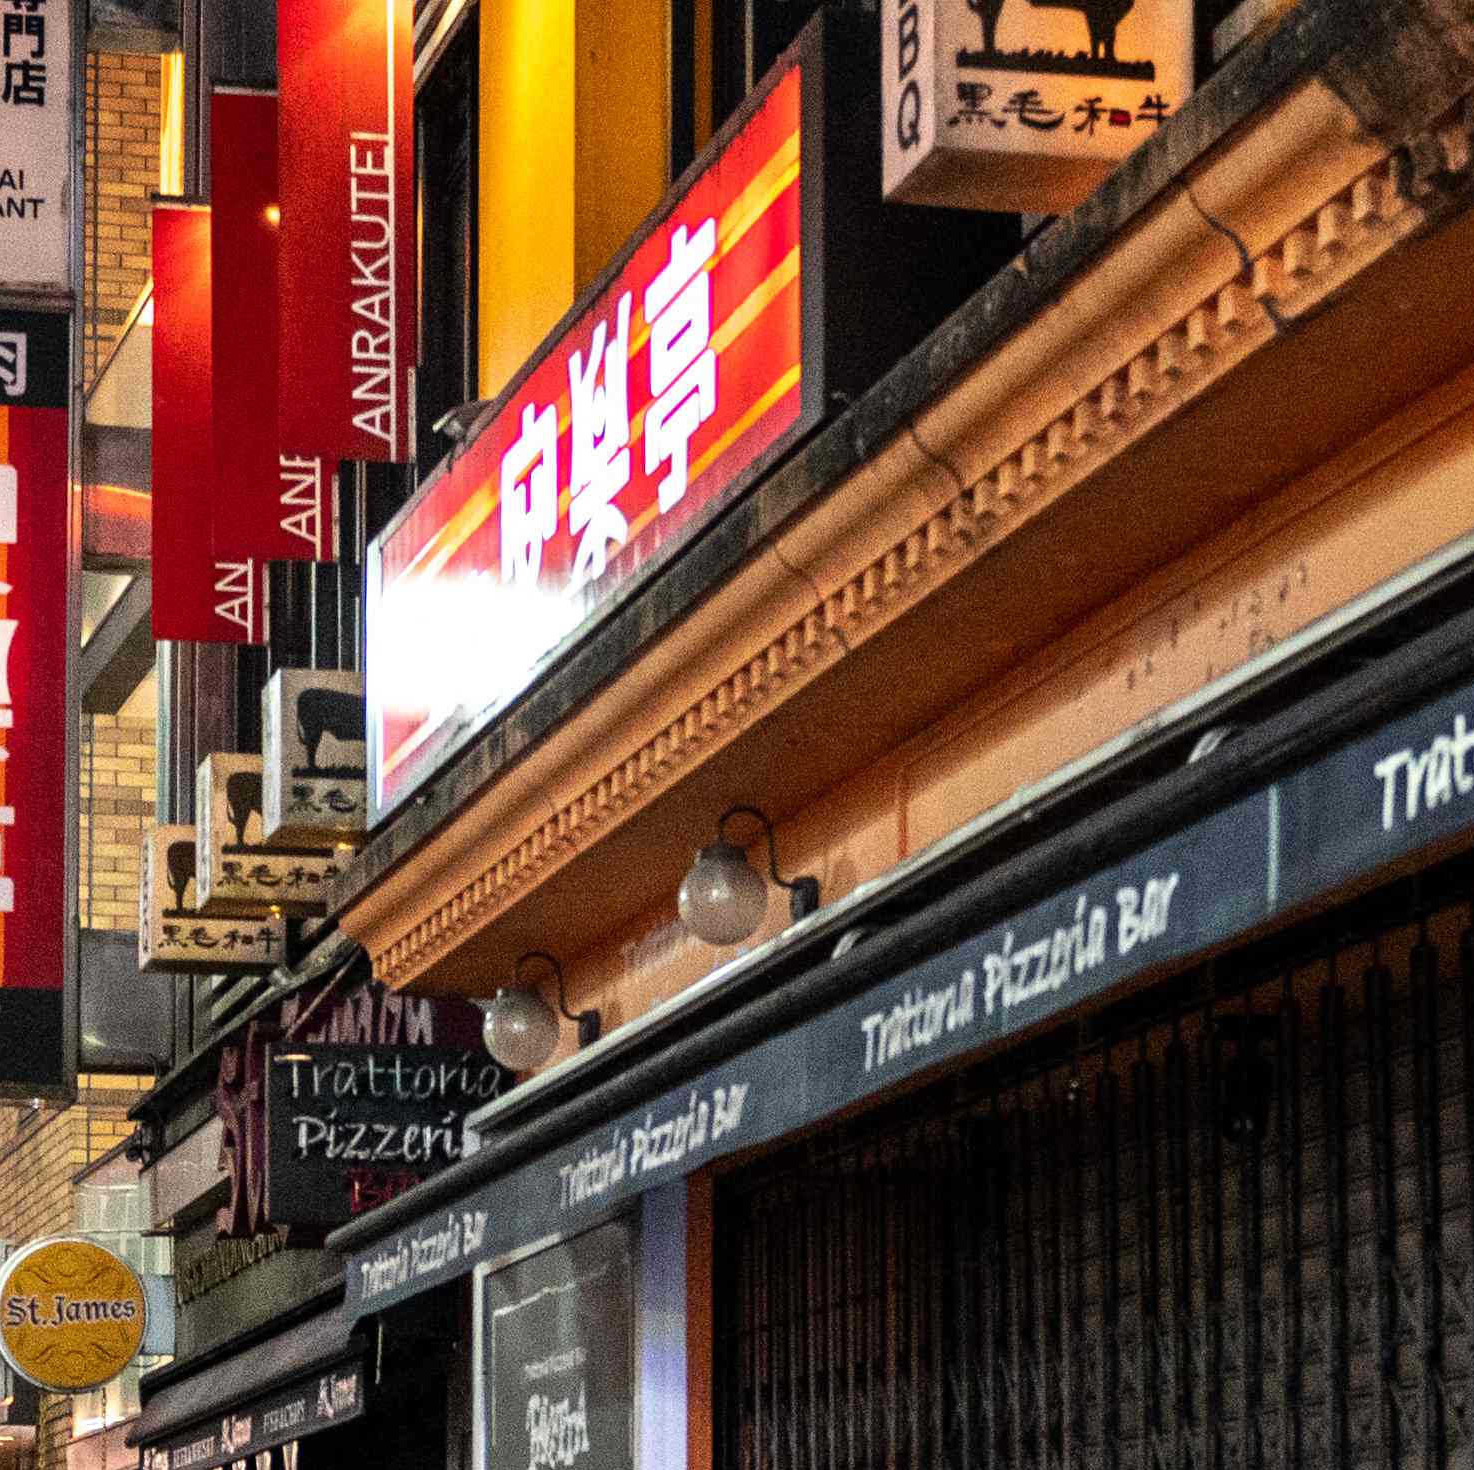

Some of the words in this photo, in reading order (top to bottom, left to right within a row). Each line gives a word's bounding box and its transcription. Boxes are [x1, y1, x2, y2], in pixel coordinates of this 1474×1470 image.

[898, 0, 920, 150] BQ
[947, 81, 1172, 135] 黒毛和牛
[352, 131, 392, 443] ANRAKUTEI
[158, 924, 280, 952] 黒毛和牛
[860, 970, 974, 1071] Trattoria
[984, 896, 1105, 1015] Pizzeria
[1117, 873, 1179, 956] Bar
[274, 1052, 502, 1101] Trattoria
[293, 1108, 467, 1162] Pizzeri
[713, 1083, 749, 1137] Bar
